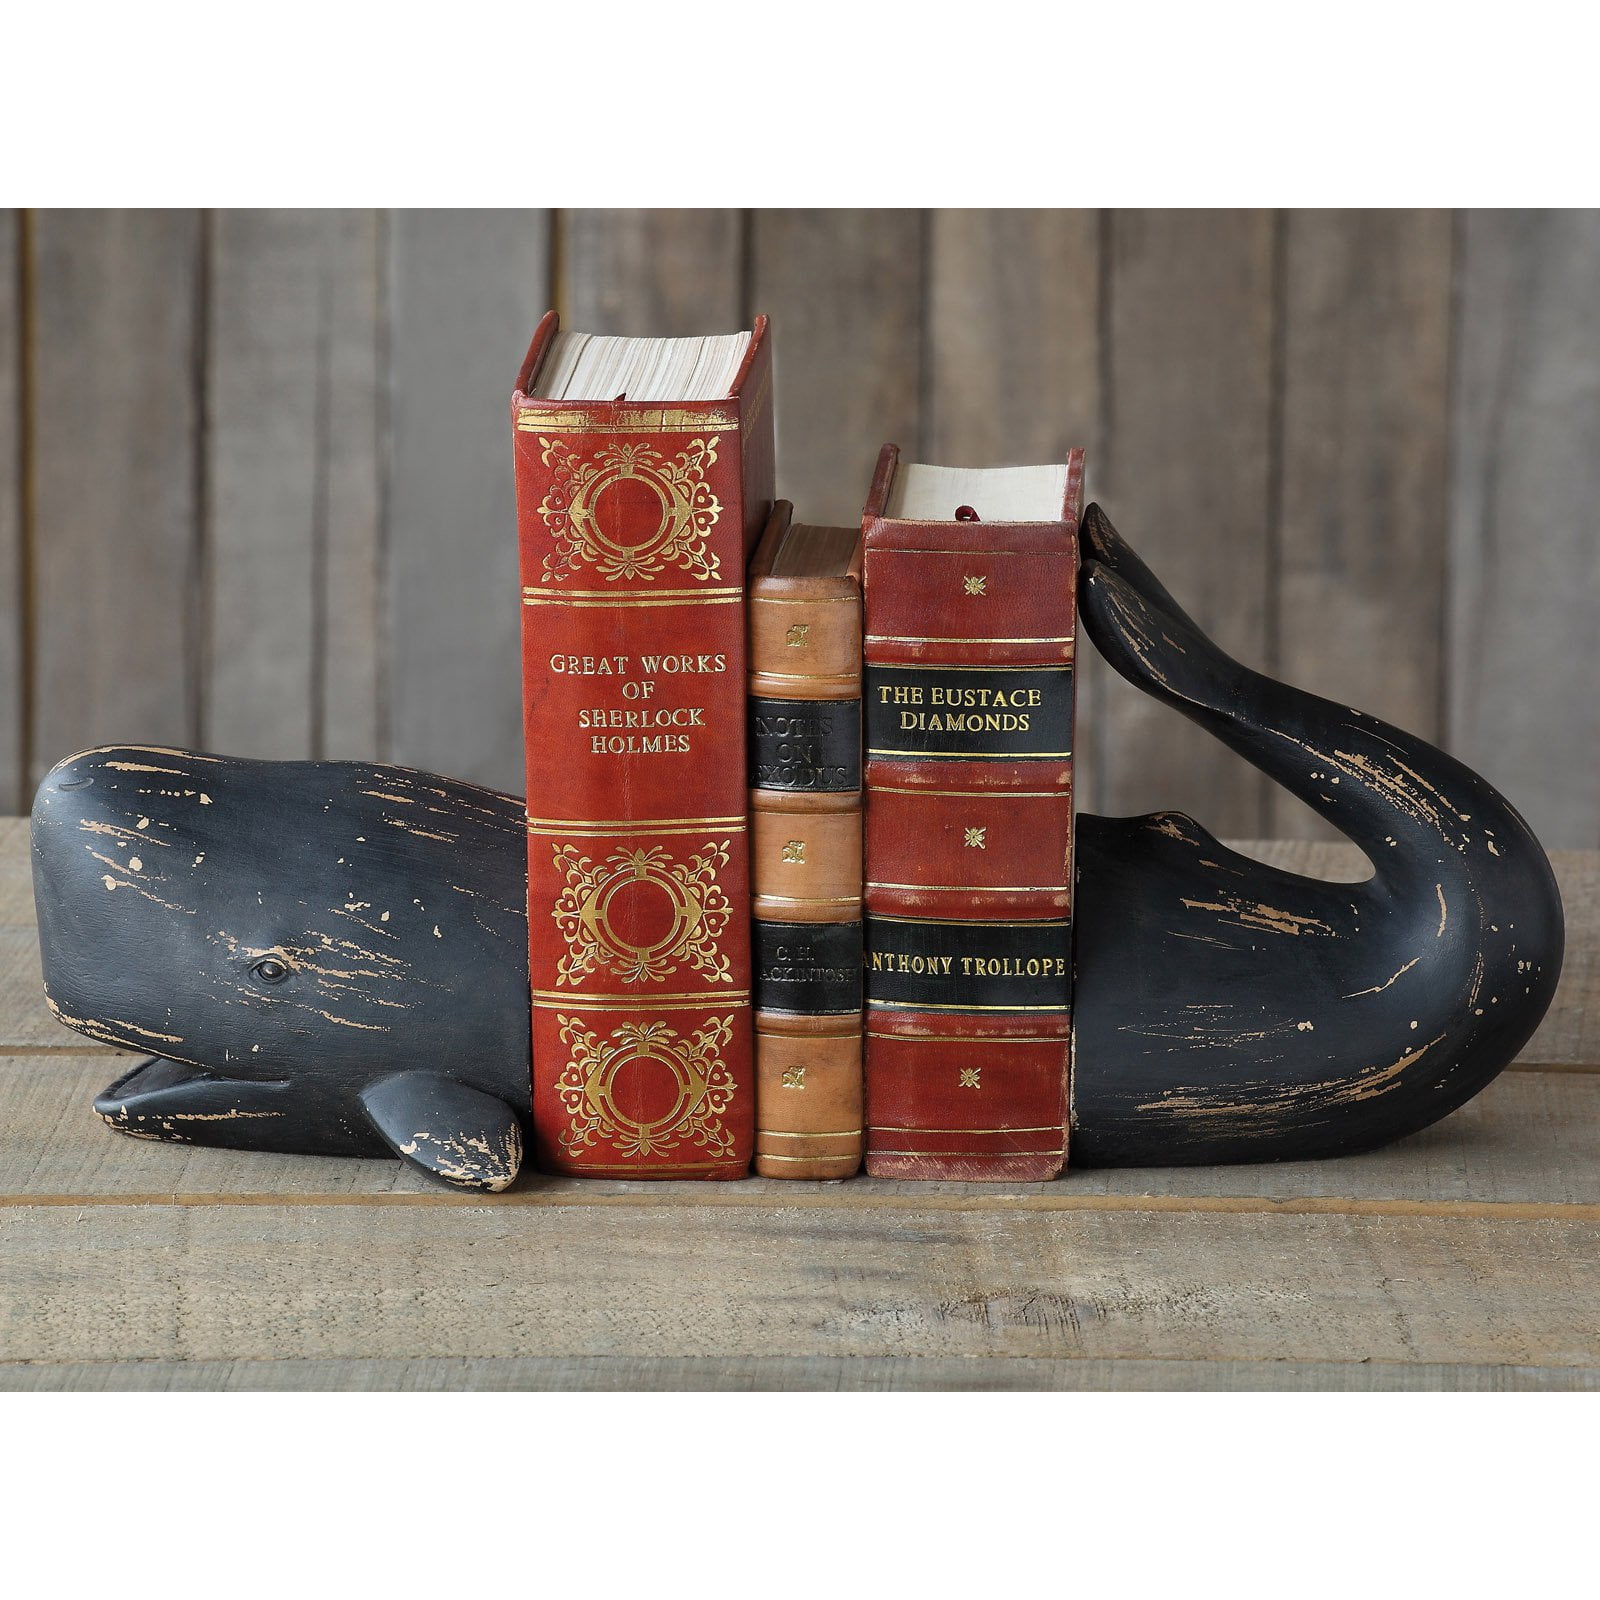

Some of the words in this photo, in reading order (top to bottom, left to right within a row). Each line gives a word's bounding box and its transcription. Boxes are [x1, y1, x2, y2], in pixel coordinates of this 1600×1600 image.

[549, 653, 629, 675] GREAT
[641, 654, 727, 674] WORKS
[622, 681, 655, 700] OF
[878, 685, 923, 705] THE
[930, 687, 1043, 708] EUSTACE
[578, 708, 706, 729] SHERLOCK
[755, 716, 833, 738] NOTES
[900, 711, 1031, 732] DIAMONDS
[590, 734, 691, 754] HOLMES
[776, 743, 815, 764] ON
[961, 957, 1065, 977] TROLLOPE
